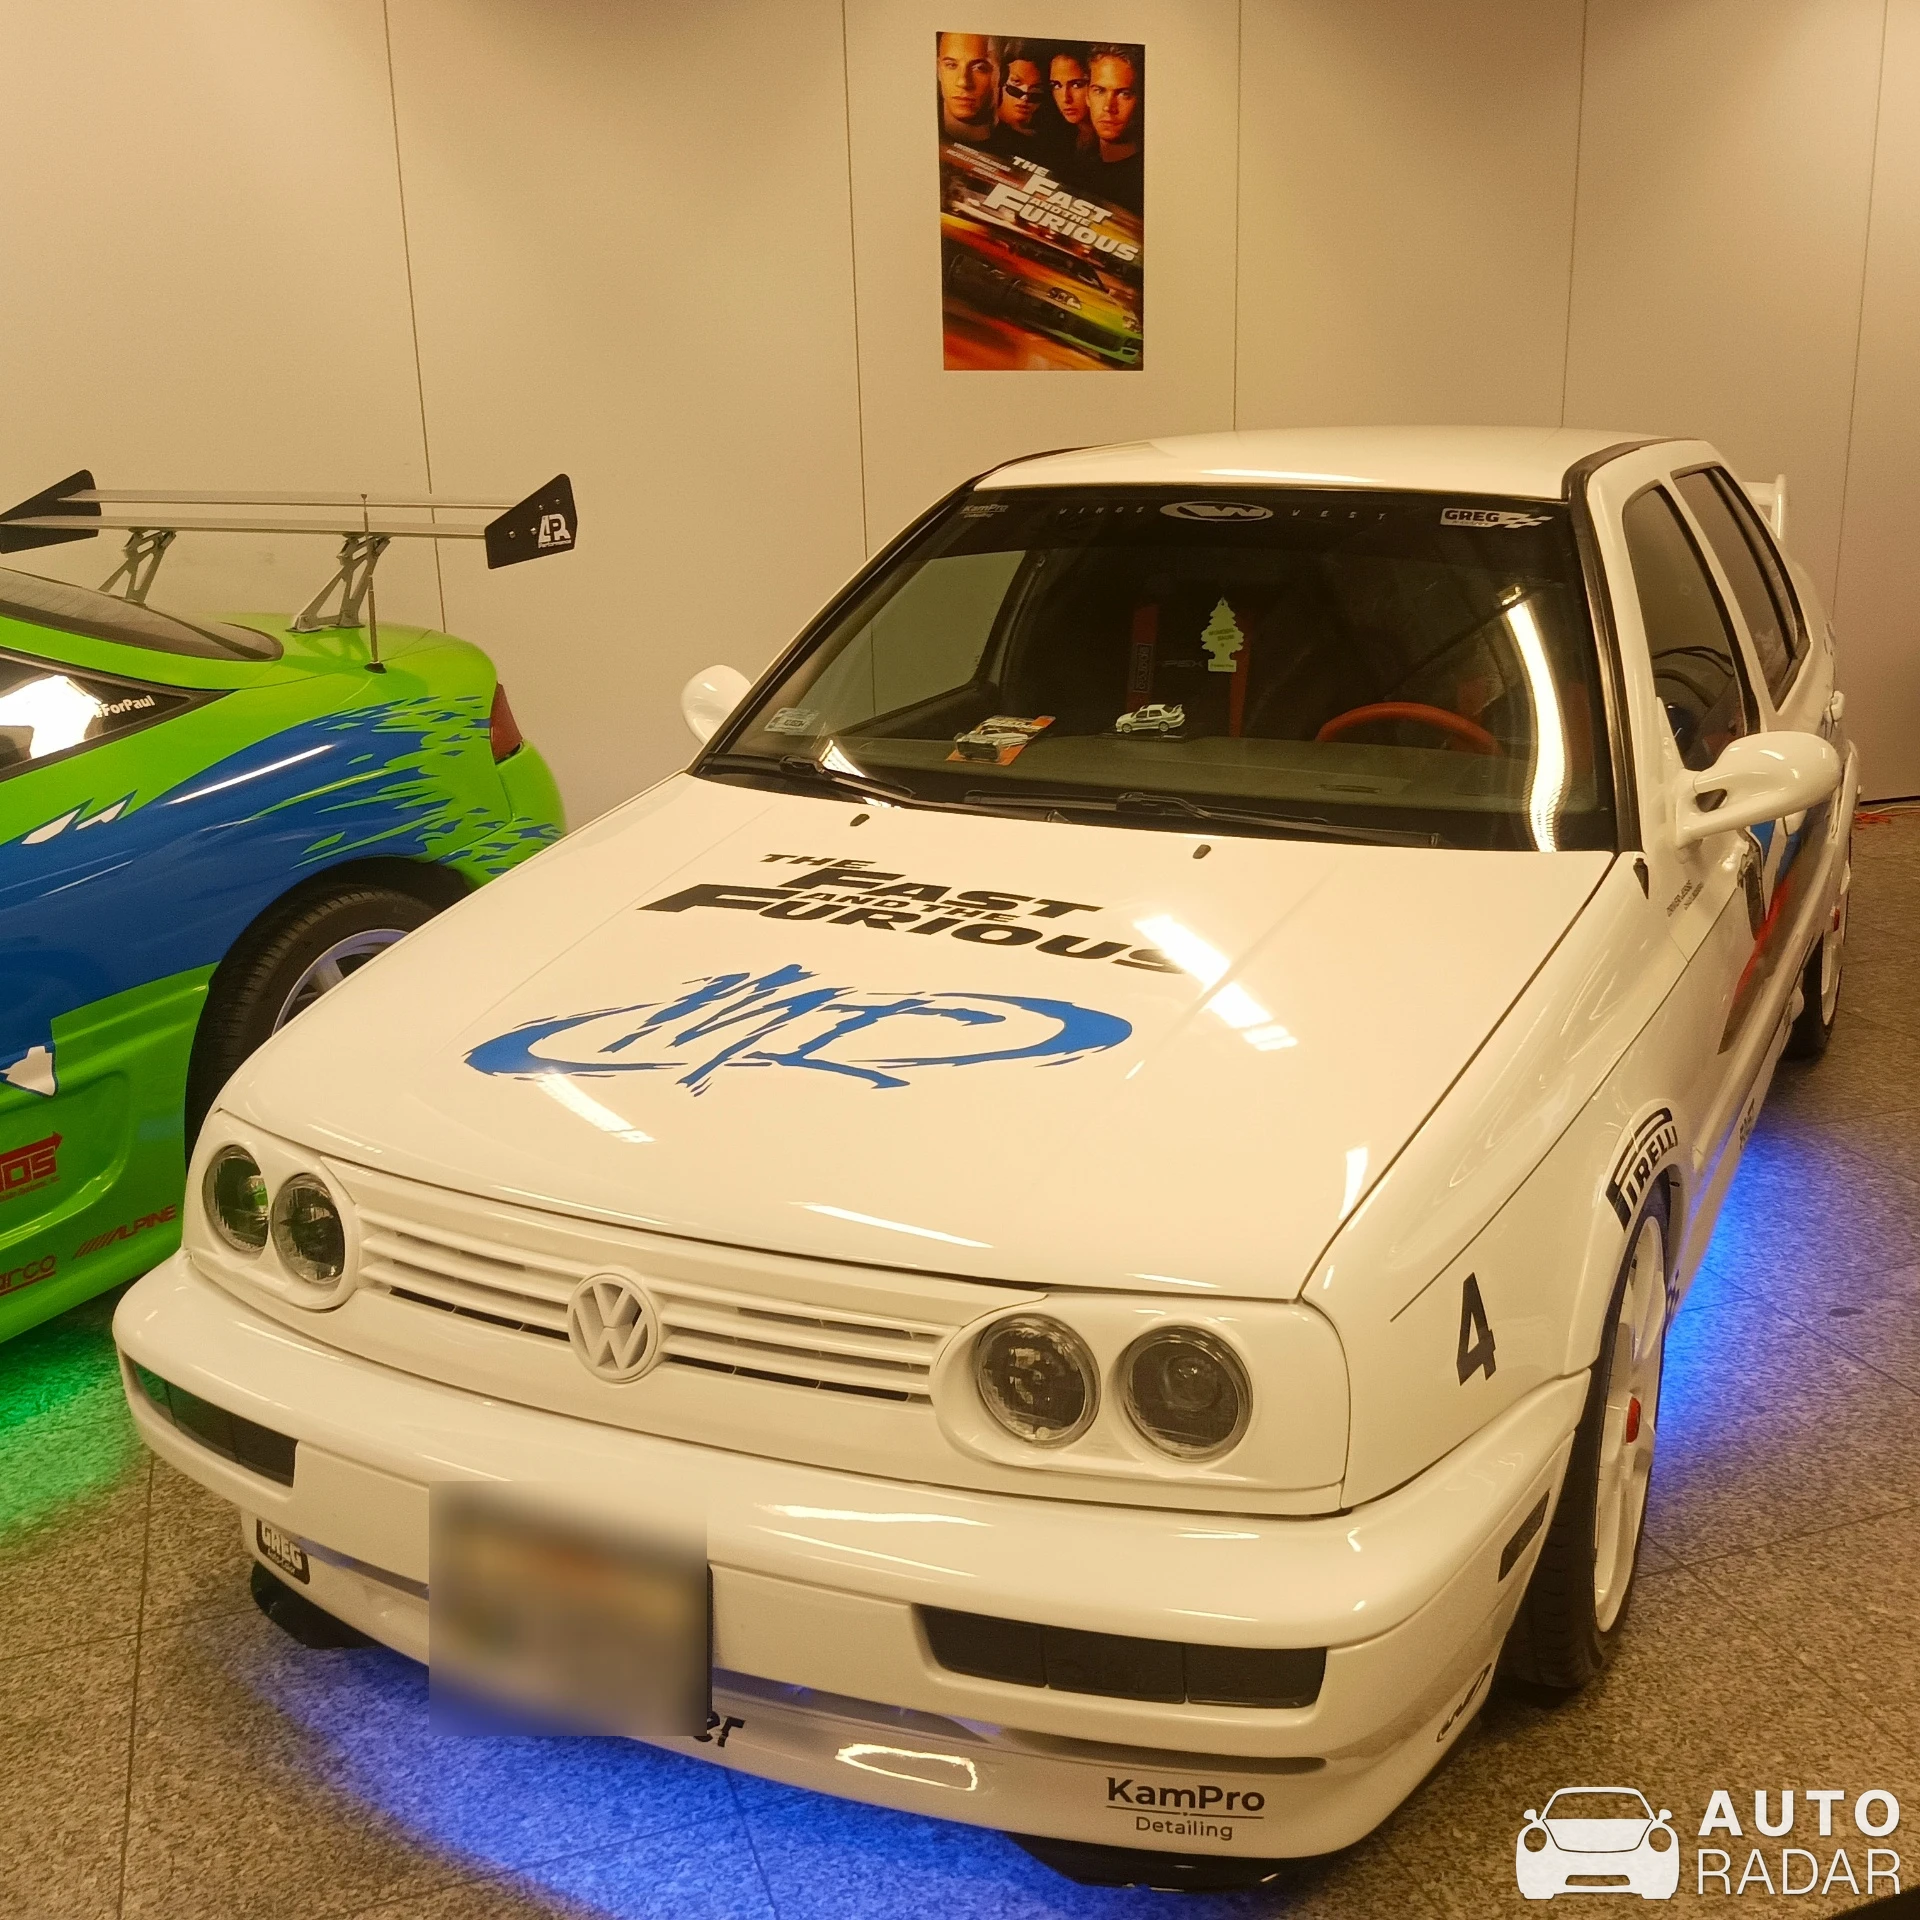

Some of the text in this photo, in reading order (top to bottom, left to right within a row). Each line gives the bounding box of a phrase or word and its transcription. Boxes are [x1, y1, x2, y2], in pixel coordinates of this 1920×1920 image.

[1013, 156, 1049, 177] THE
[982, 183, 1138, 262] FURIOUS
[1022, 174, 1113, 225] FAST
[1445, 510, 1500, 523] GREG
[761, 853, 877, 870] THE
[778, 868, 1104, 919] FAST
[793, 891, 1021, 923] AND THE
[636, 883, 1186, 975] FURIOUS
[0, 1144, 58, 1193] OS
[1605, 1107, 1679, 1233] PIRELLI
[1456, 1271, 1497, 1387] 4
[262, 1523, 304, 1570] GREG
[1107, 1776, 1265, 1812] KamPro
[1136, 1816, 1233, 1842] Detailing
